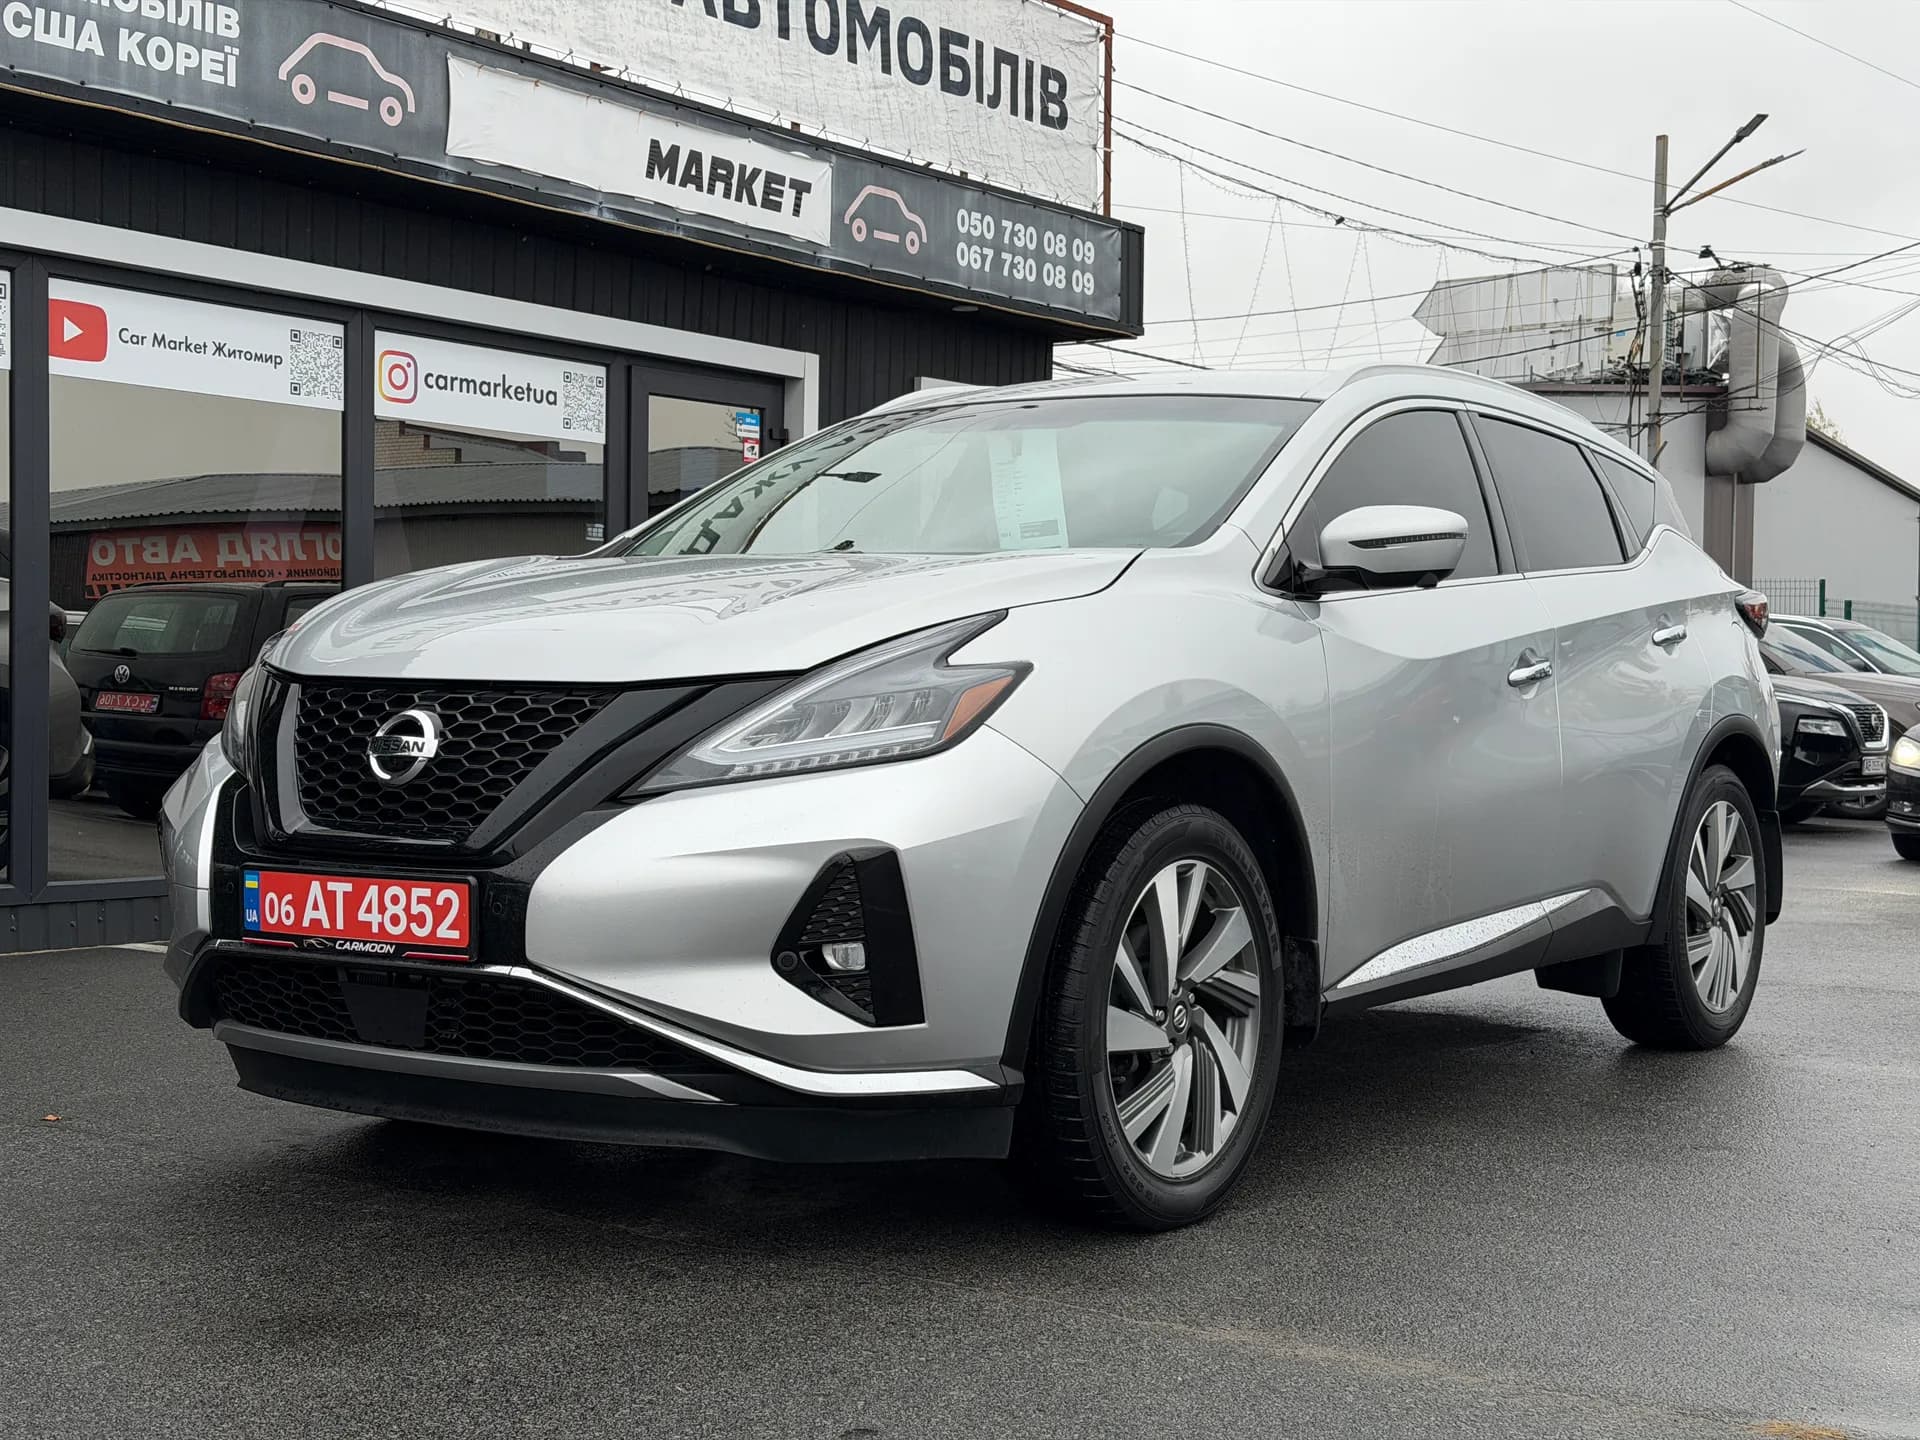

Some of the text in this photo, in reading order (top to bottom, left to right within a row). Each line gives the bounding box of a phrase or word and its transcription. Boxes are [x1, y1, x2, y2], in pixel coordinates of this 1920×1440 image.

[3, 2, 240, 88] США КОРЕЇ
[645, 138, 813, 218] MARKET
[957, 208, 1095, 265] 050 730 08 09
[956, 240, 1095, 296] 067 730 08 09
[118, 327, 284, 369] Car Market Житомир
[423, 371, 558, 406] carmarketua
[245, 908, 258, 922] UA
[264, 880, 460, 940] 06 AT 4852
[335, 940, 396, 954] CARMOON
